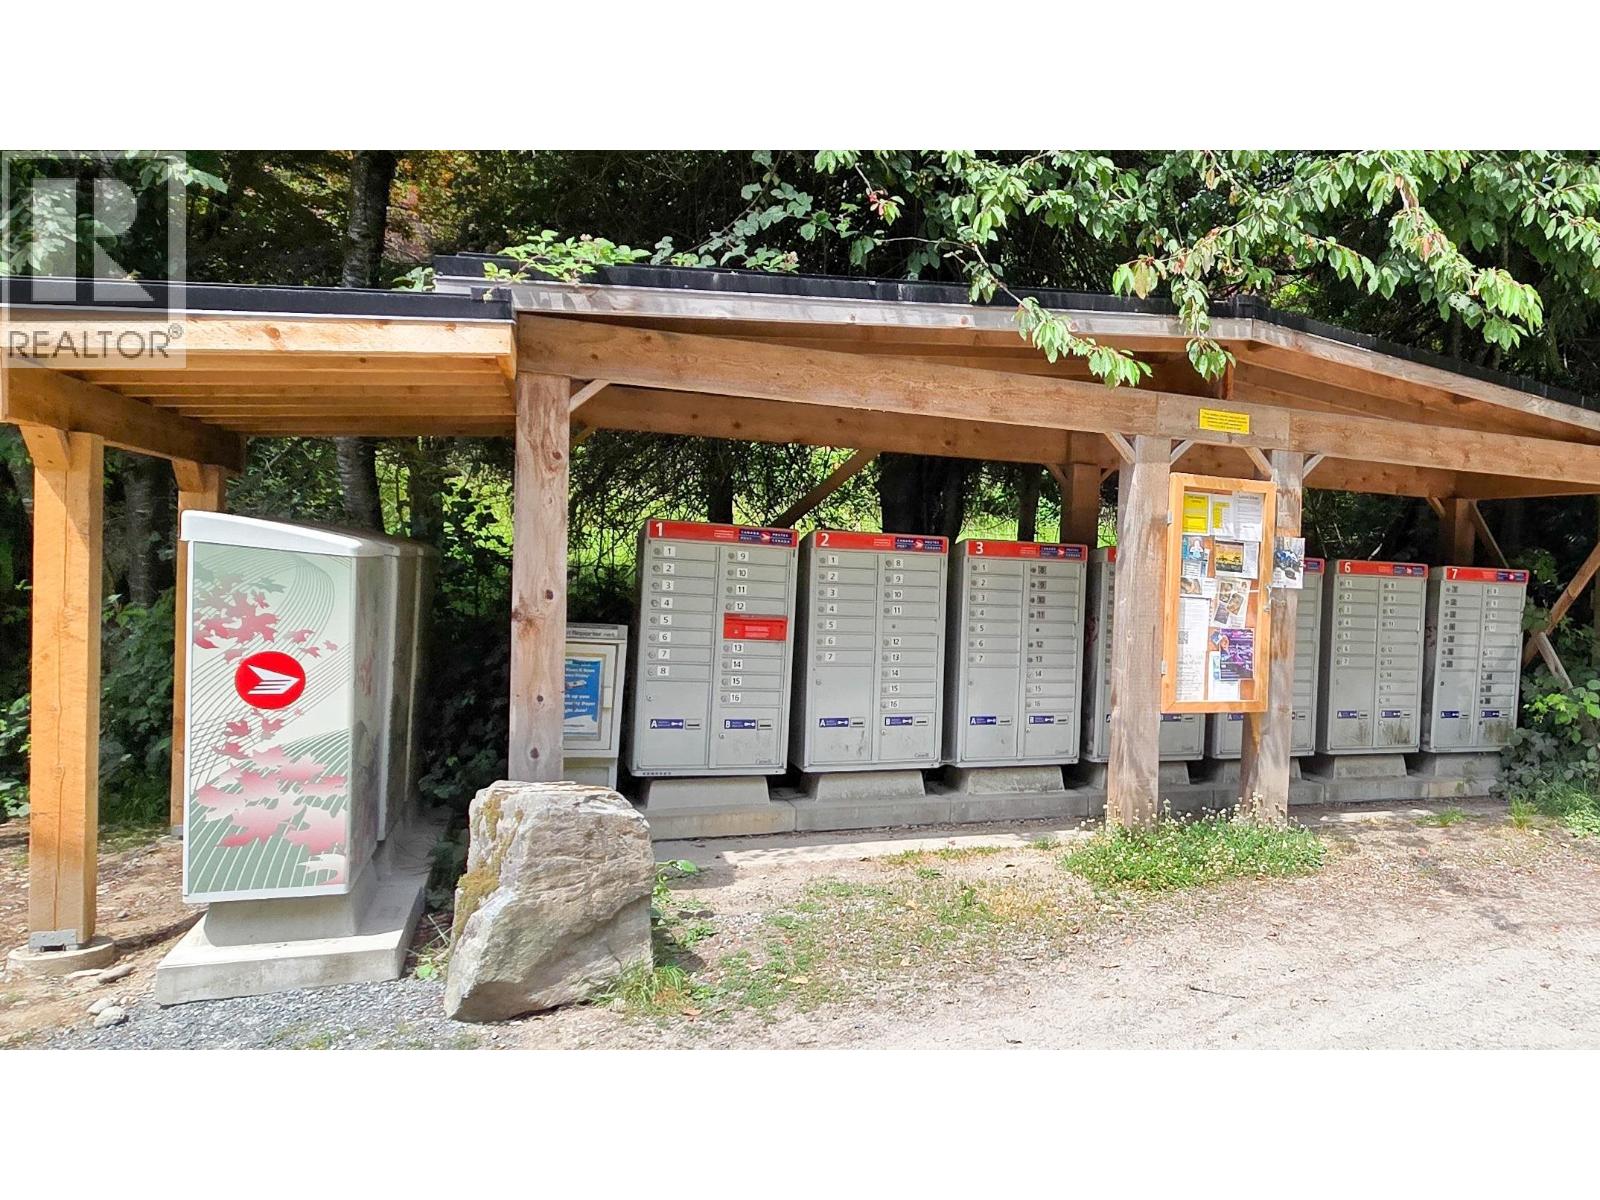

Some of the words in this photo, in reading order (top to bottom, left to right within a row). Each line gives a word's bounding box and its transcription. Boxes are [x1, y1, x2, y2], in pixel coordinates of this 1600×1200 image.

[656, 522, 663, 536] 1
[821, 533, 829, 546] 2
[976, 542, 984, 554] 3
[1345, 562, 1351, 573] 6
[1452, 569, 1457, 579] 7
